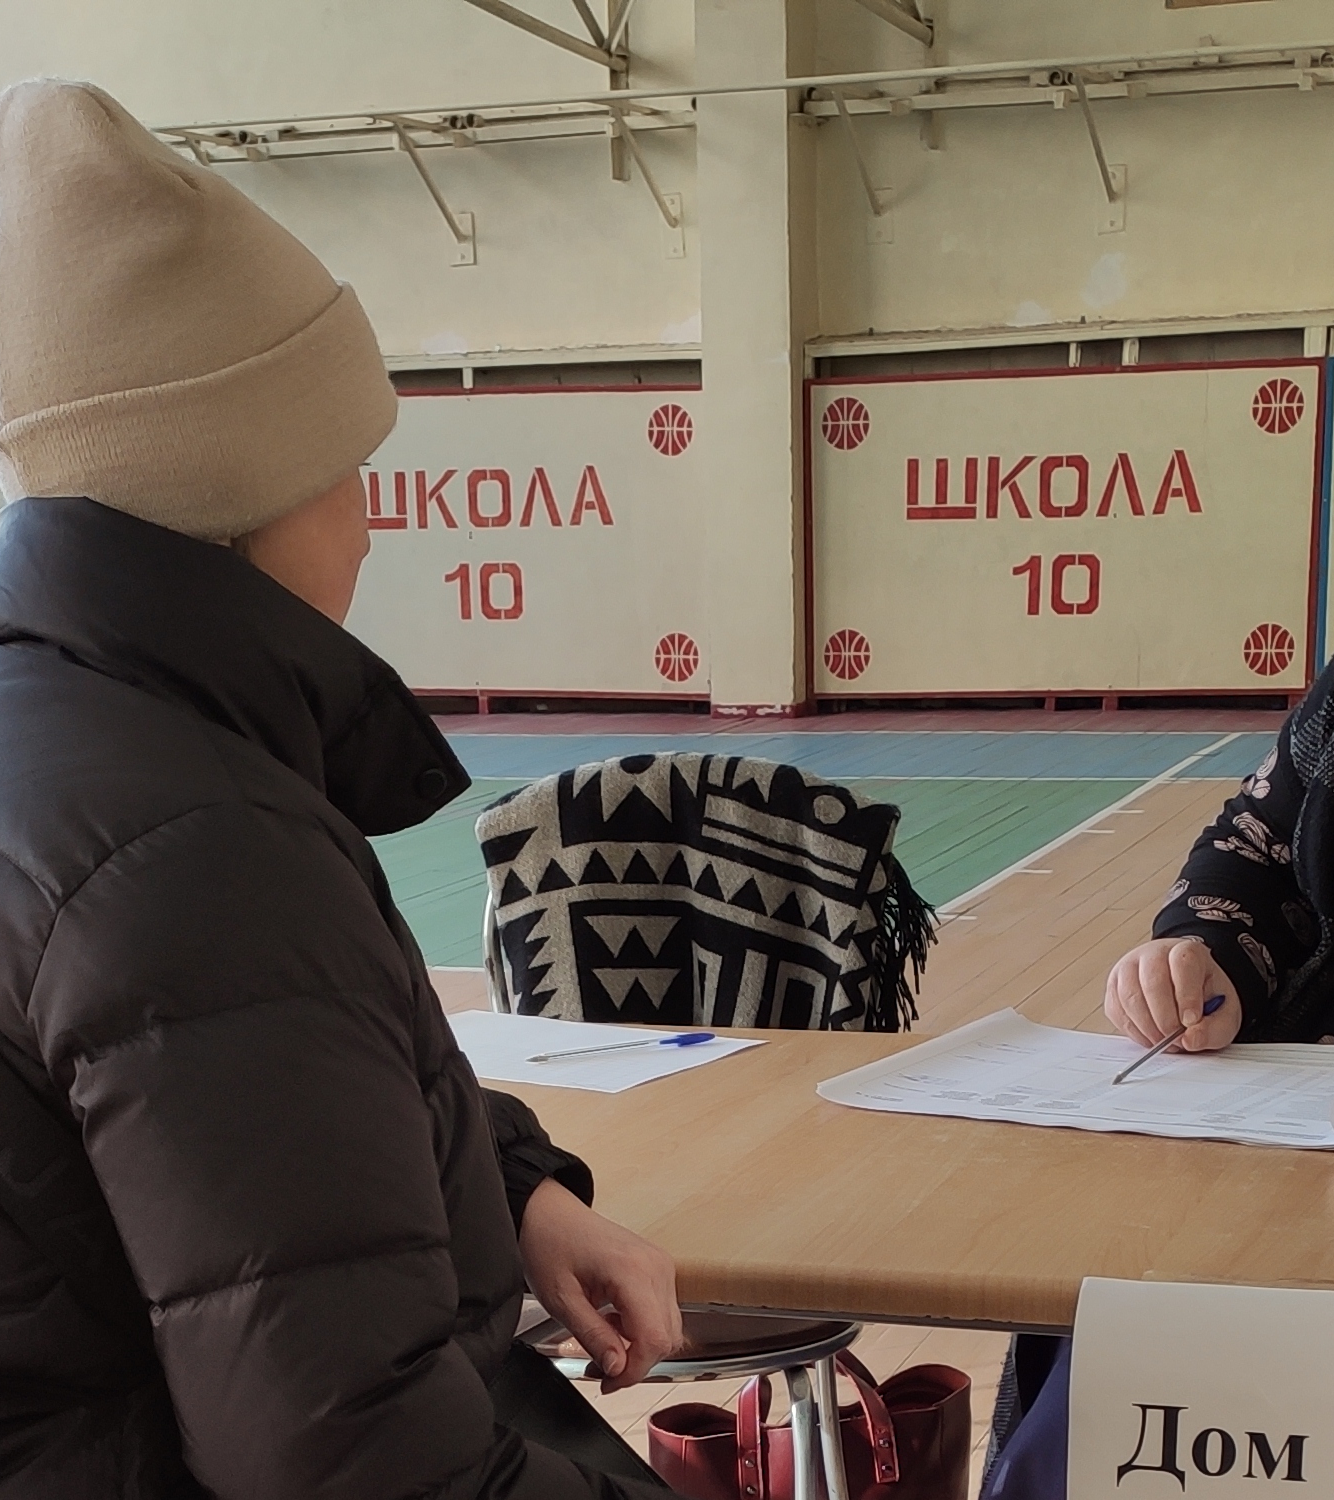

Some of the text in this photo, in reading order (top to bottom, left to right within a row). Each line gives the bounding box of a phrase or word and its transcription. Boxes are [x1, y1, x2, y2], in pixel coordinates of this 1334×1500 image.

[366, 465, 614, 530] ШКОЛА
[905, 449, 1203, 521] ШКОЛА
[444, 562, 524, 621] 10
[1012, 553, 1101, 616] 10
[1116, 1402, 1310, 1493] Дом
